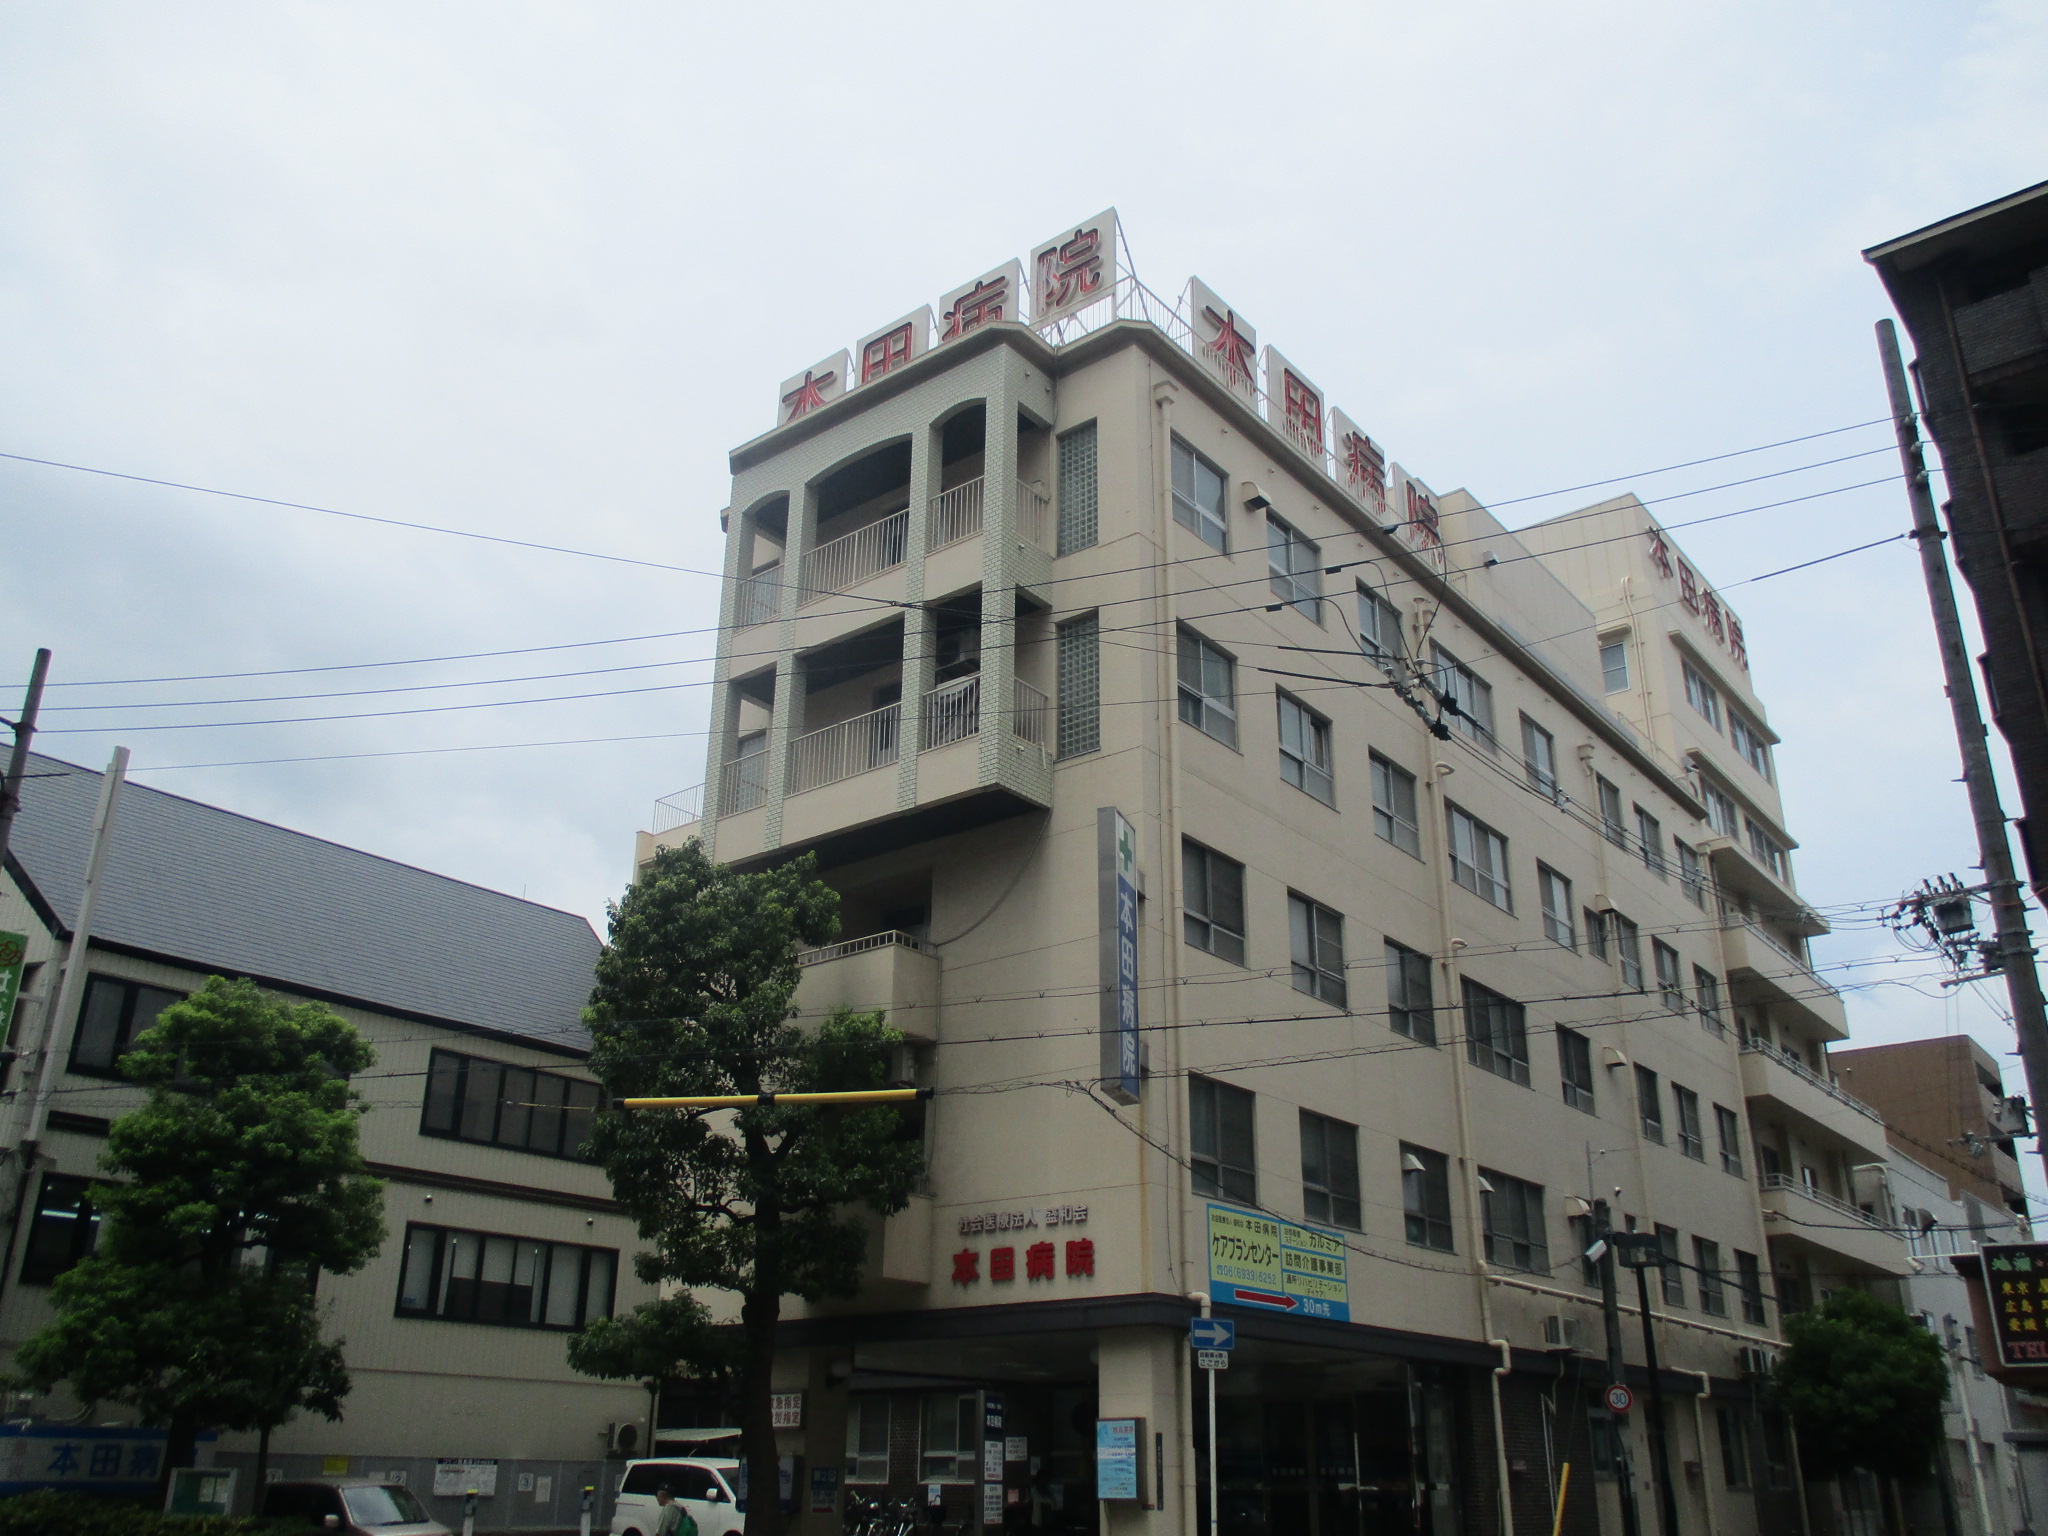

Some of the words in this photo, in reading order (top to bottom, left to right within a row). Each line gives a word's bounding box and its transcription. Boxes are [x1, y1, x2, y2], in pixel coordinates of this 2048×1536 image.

[1648, 525, 1748, 670] 本田病院
[1120, 891, 1136, 1077] 本田病院
[959, 1208, 1038, 1232] 社会医療法人
[1245, 1220, 1277, 1237] 本田病院
[1212, 1232, 1278, 1266] ケアプランセンター
[1309, 1232, 1340, 1252] カルミア
[952, 1238, 1094, 1287] 本田病院
[1286, 1274, 1343, 1292] 通所リハビリテーション
[1303, 1298, 1330, 1316] 30m先
[1200, 1359, 1227, 1367] ここから
[1611, 1392, 1626, 1405] 30
